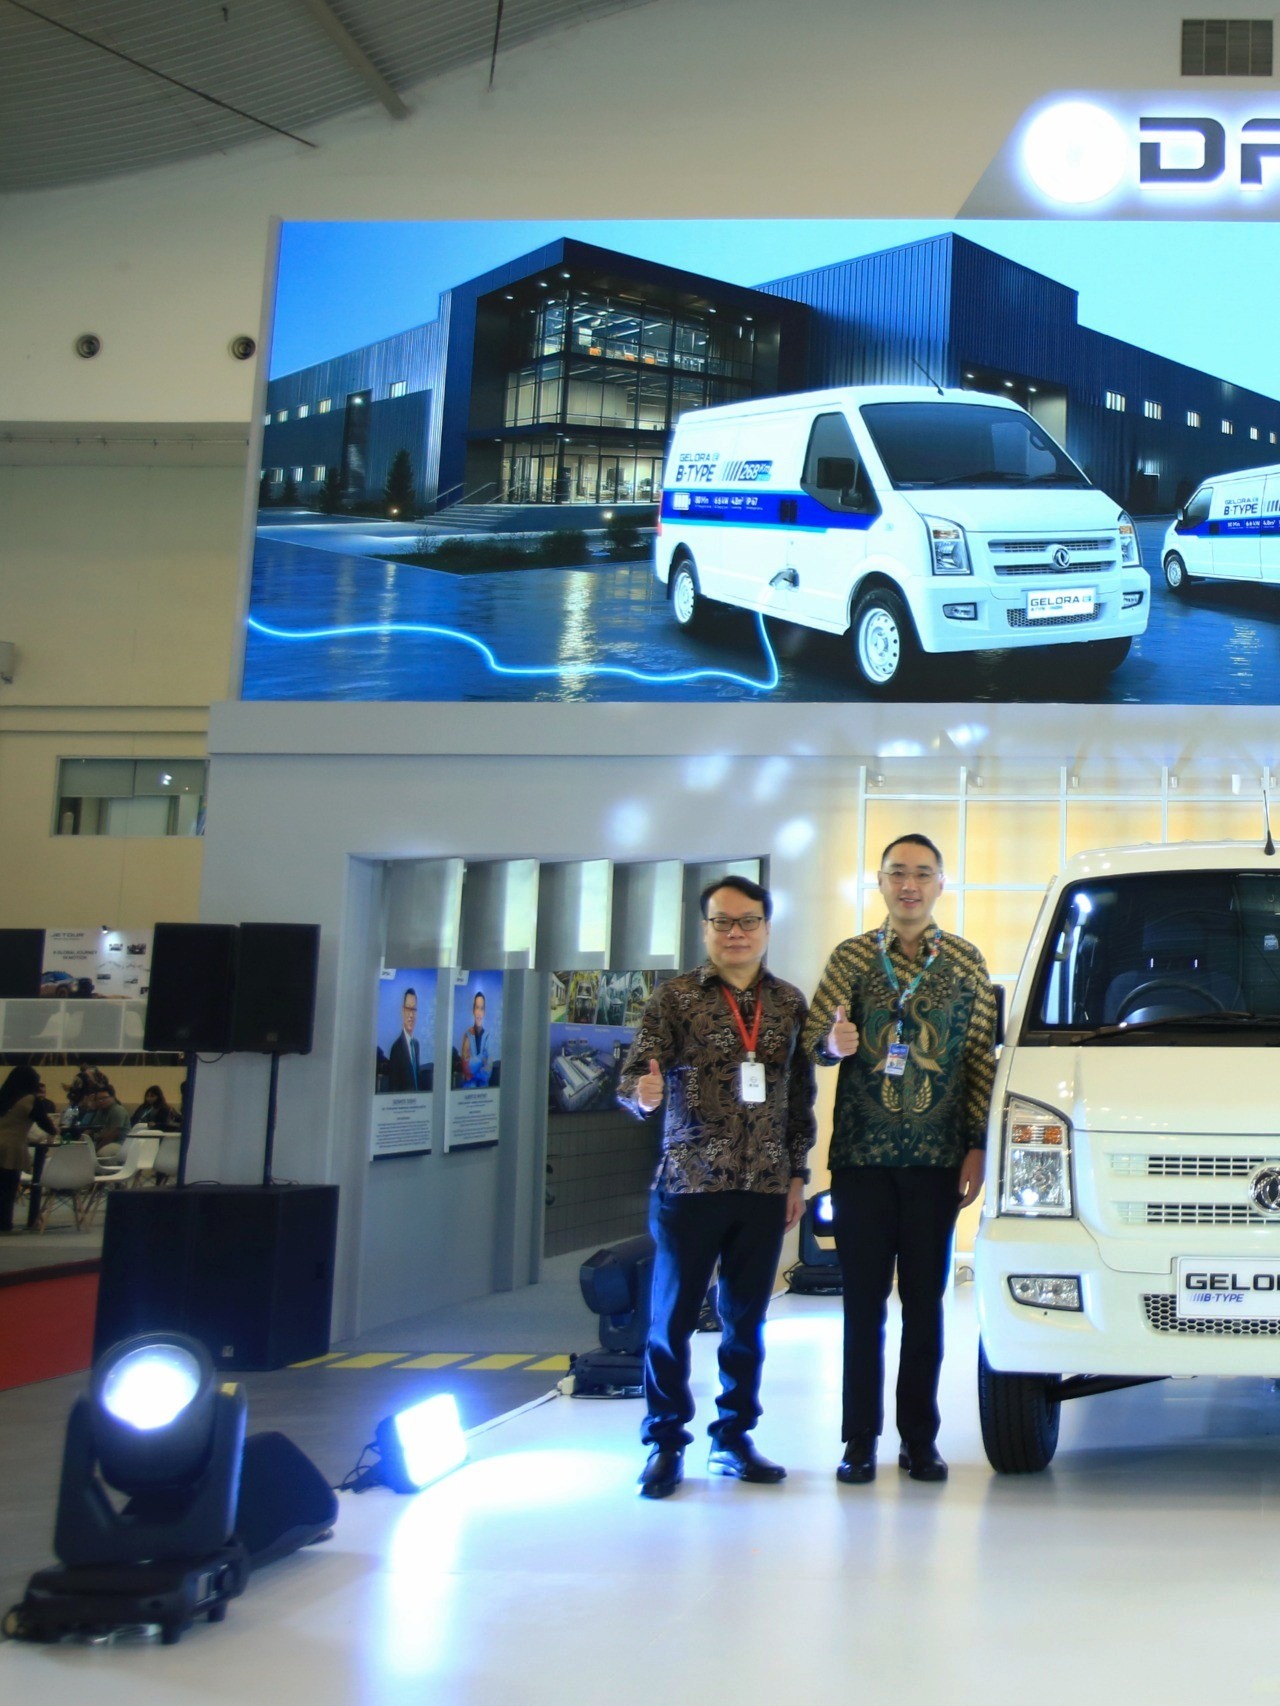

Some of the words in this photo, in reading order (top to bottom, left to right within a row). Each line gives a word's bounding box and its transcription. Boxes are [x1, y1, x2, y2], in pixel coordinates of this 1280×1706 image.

[679, 453, 710, 462] GELORA
[676, 464, 716, 482] B-TYPE
[739, 463, 760, 480] 268
[1224, 503, 1258, 515] B-TYPE
[1030, 596, 1080, 607] GELORA
[1203, 1293, 1244, 1303] B-TYPE
